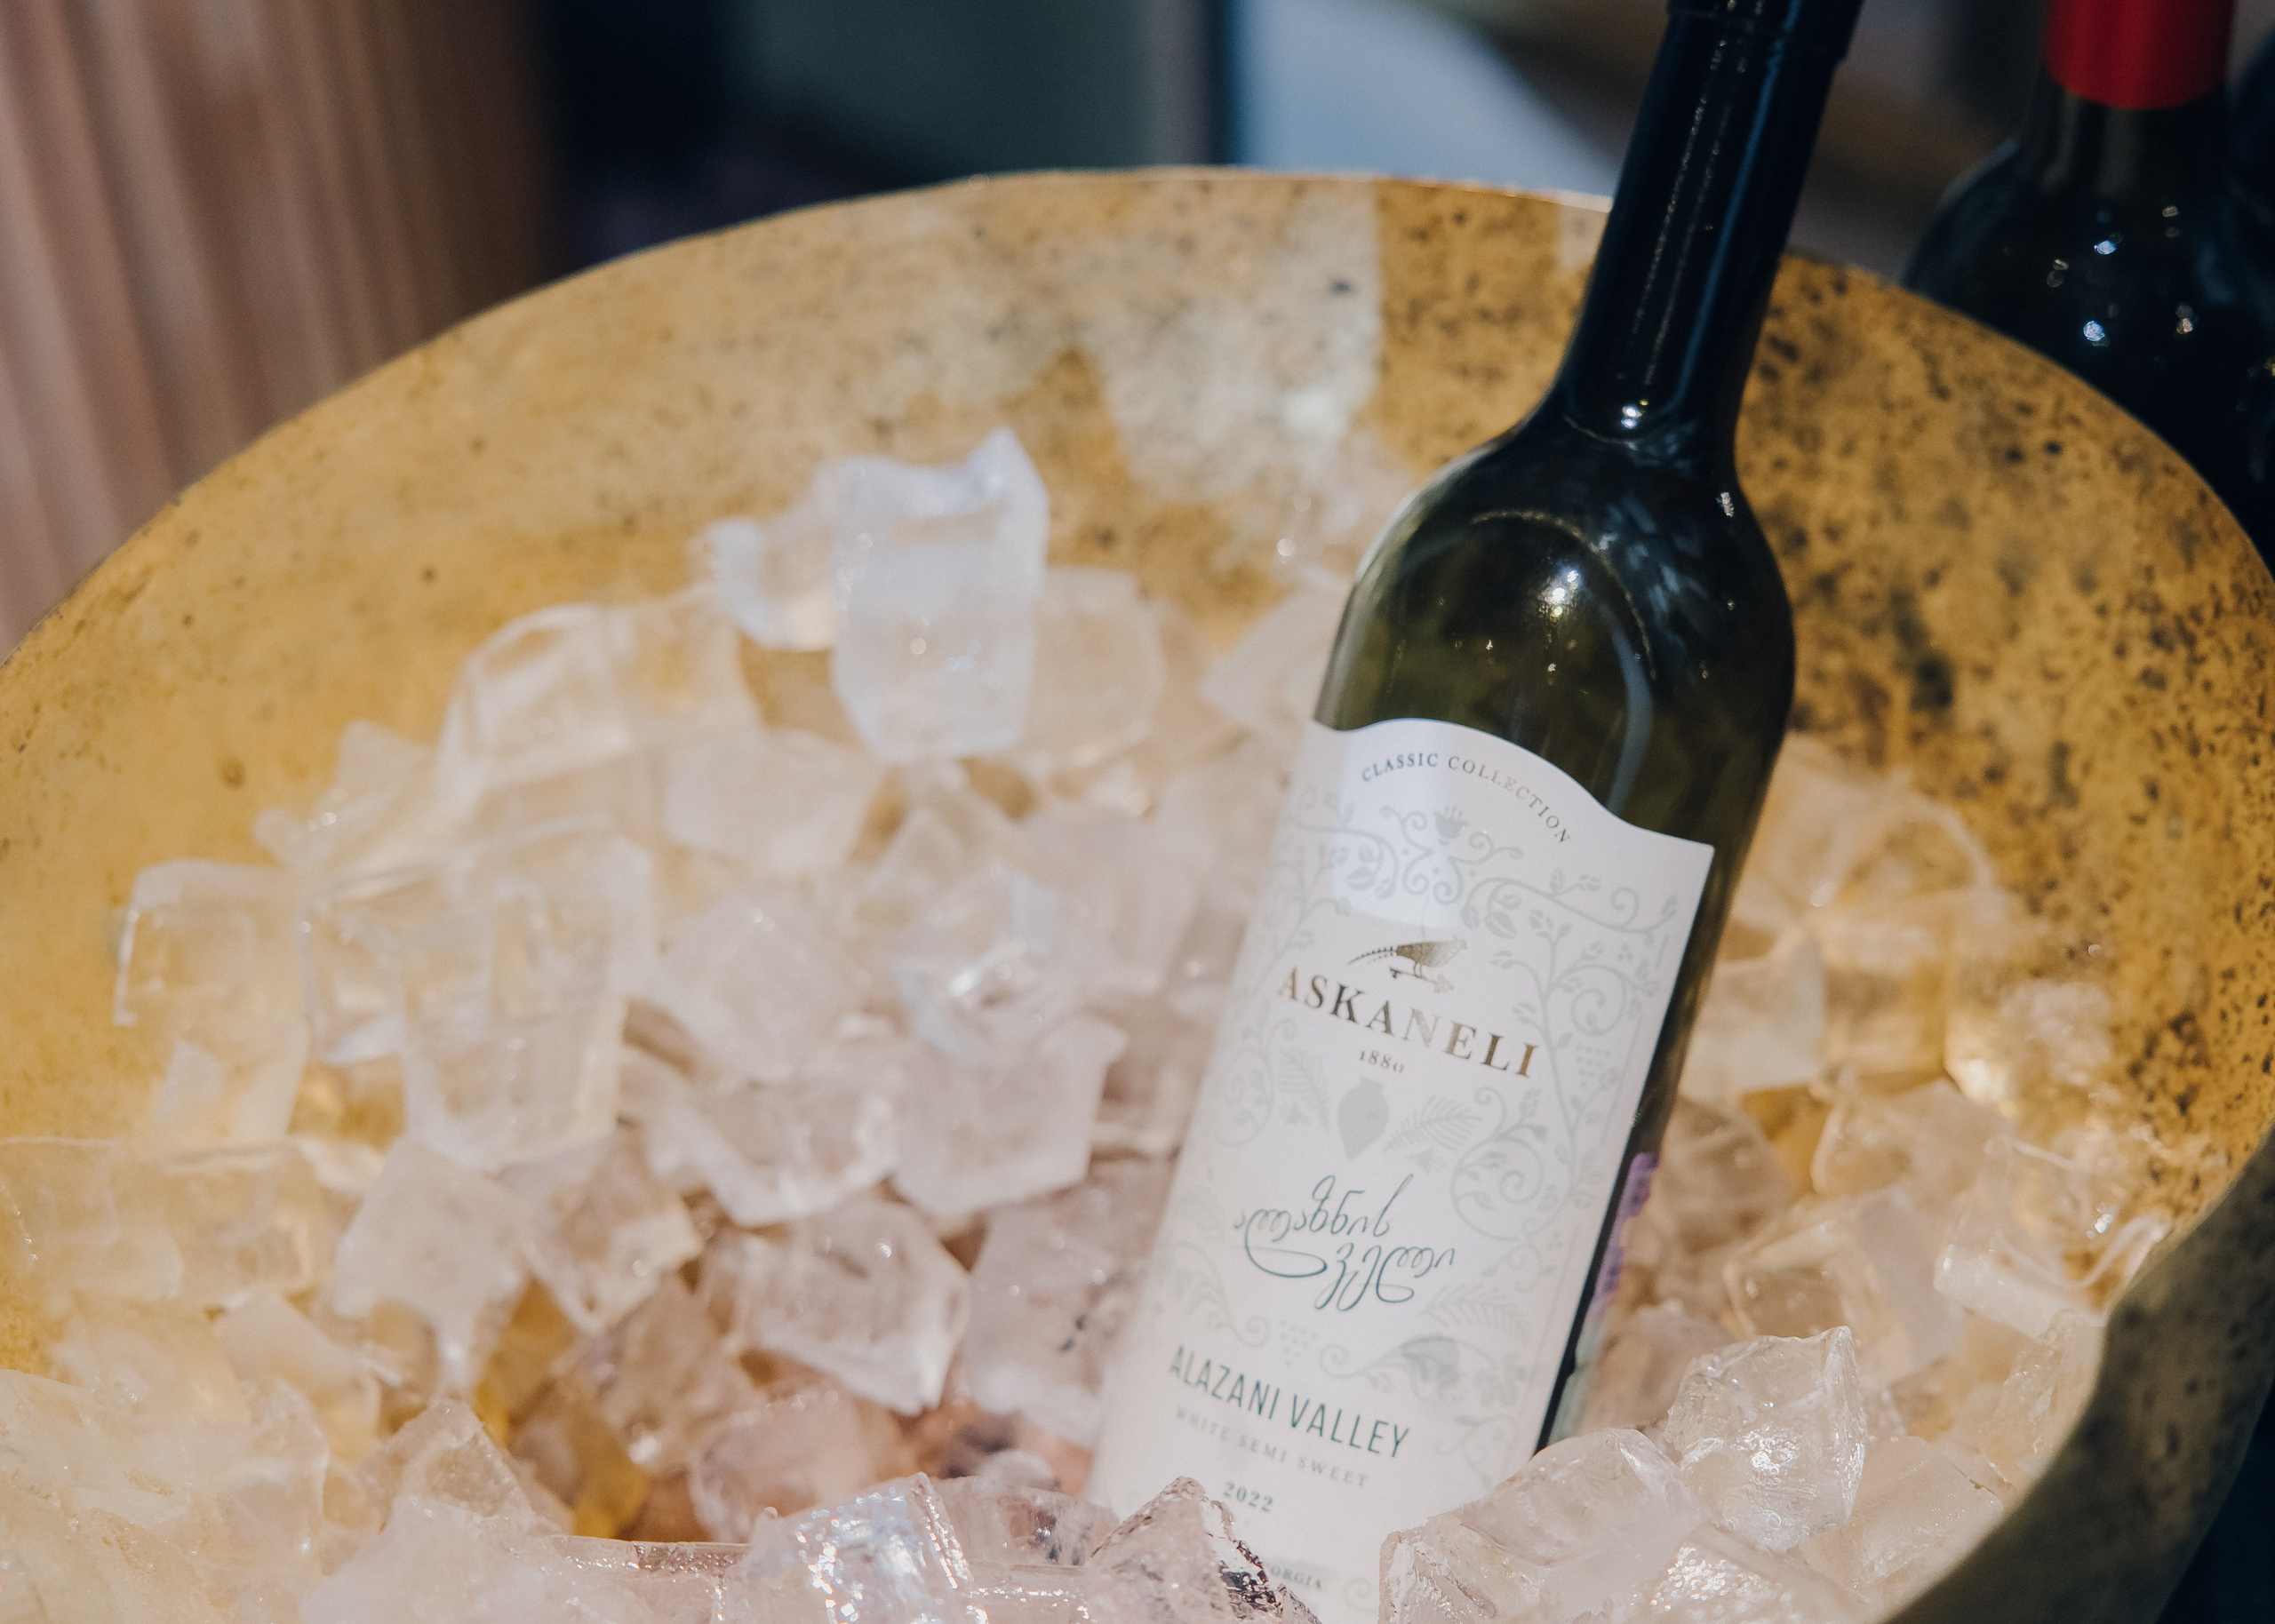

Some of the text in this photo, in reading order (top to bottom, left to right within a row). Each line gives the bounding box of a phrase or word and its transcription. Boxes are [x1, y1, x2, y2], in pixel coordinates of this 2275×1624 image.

[1361, 752, 1570, 843] CLASSIC COLLECTION
[1278, 966, 1537, 1078] ASKANELI
[1359, 1050, 1403, 1073] 1880
[1169, 1345, 1409, 1457] ALAZANI VALLEY
[1223, 1480, 1274, 1513] 2022
[1239, 1434, 1289, 1463] SEMI
[1298, 1455, 1369, 1487] SWEET
